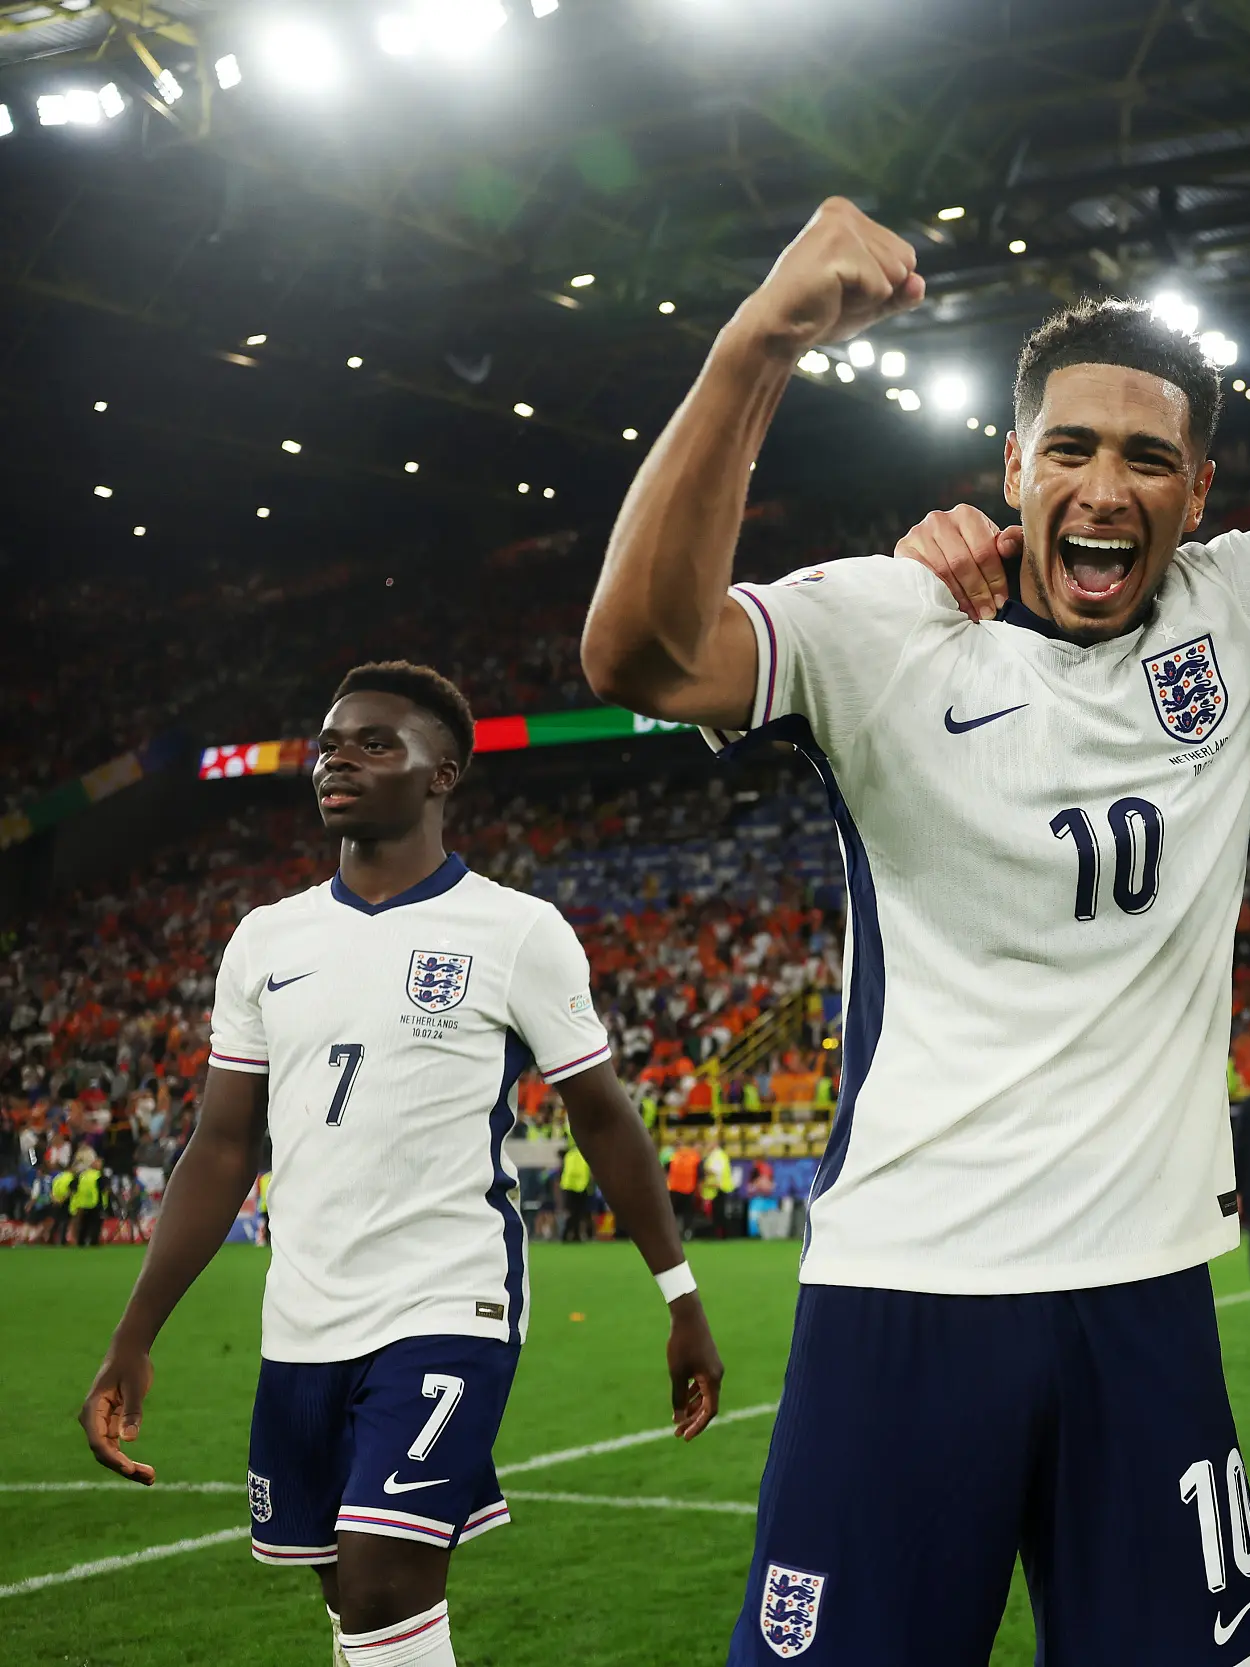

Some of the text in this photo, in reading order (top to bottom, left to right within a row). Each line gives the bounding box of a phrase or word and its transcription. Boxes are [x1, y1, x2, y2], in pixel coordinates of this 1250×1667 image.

[1168, 734, 1231, 766] NETHERLAN
[1049, 796, 1165, 921] 10
[400, 1014, 459, 1030] NETHERLANDS
[412, 1027, 443, 1040] 10.07.24
[326, 1043, 365, 1127] 7
[407, 1373, 465, 1462] 7
